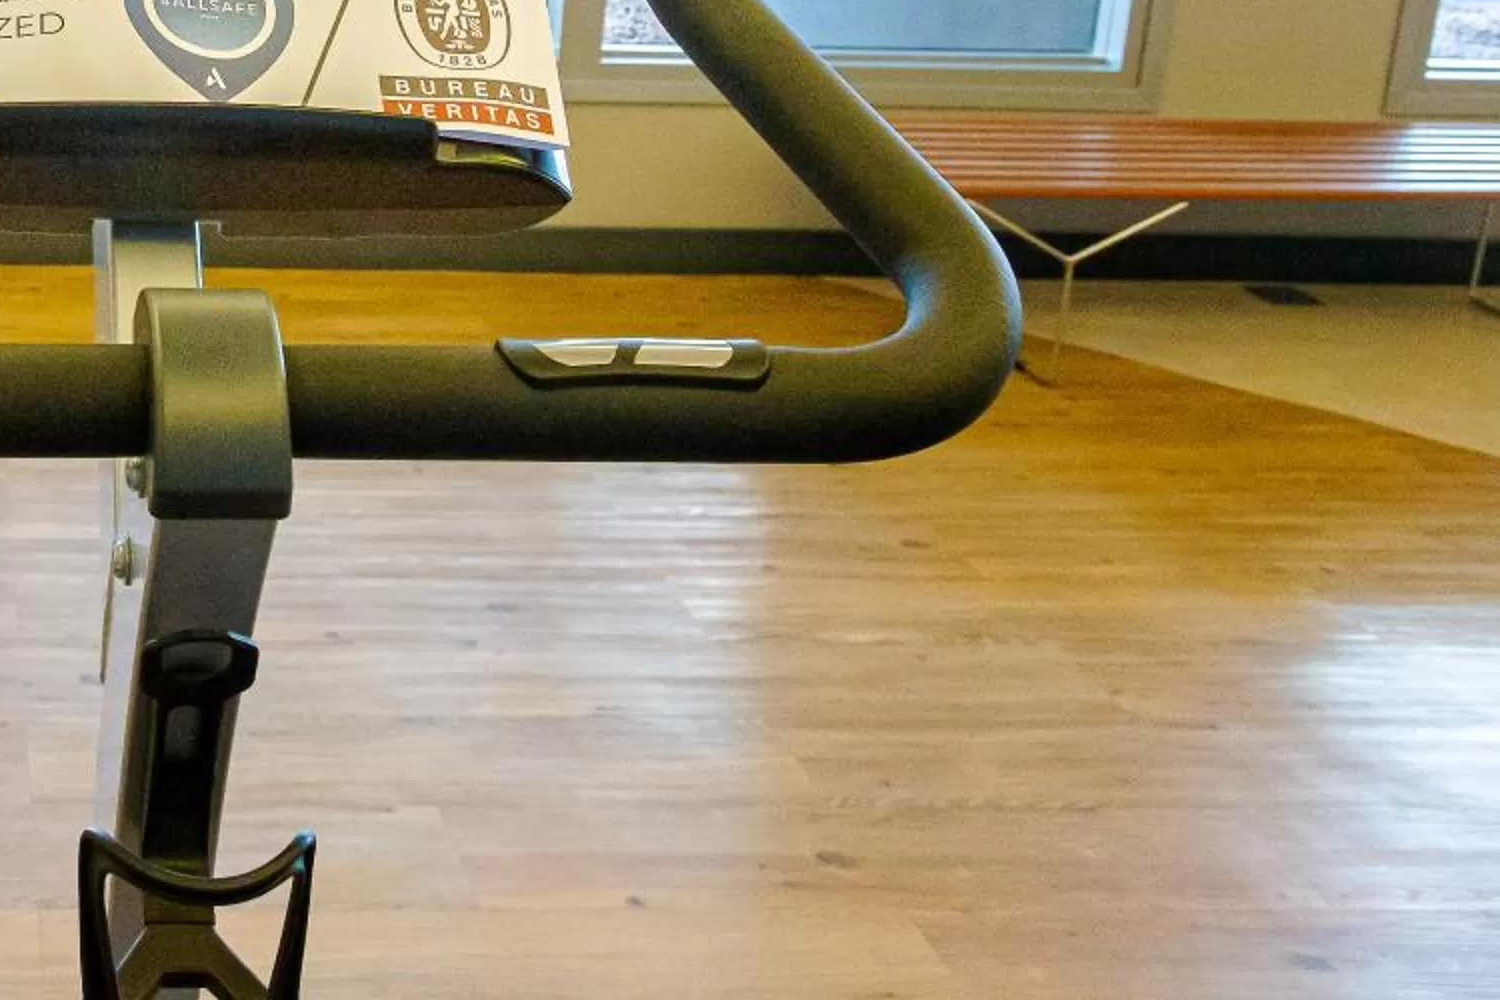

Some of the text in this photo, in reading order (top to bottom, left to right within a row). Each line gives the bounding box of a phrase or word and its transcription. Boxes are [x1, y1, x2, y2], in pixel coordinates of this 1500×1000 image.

[438, 53, 488, 67] 1828
[395, 79, 536, 104] BUREAU
[397, 102, 542, 130] VERITAS
